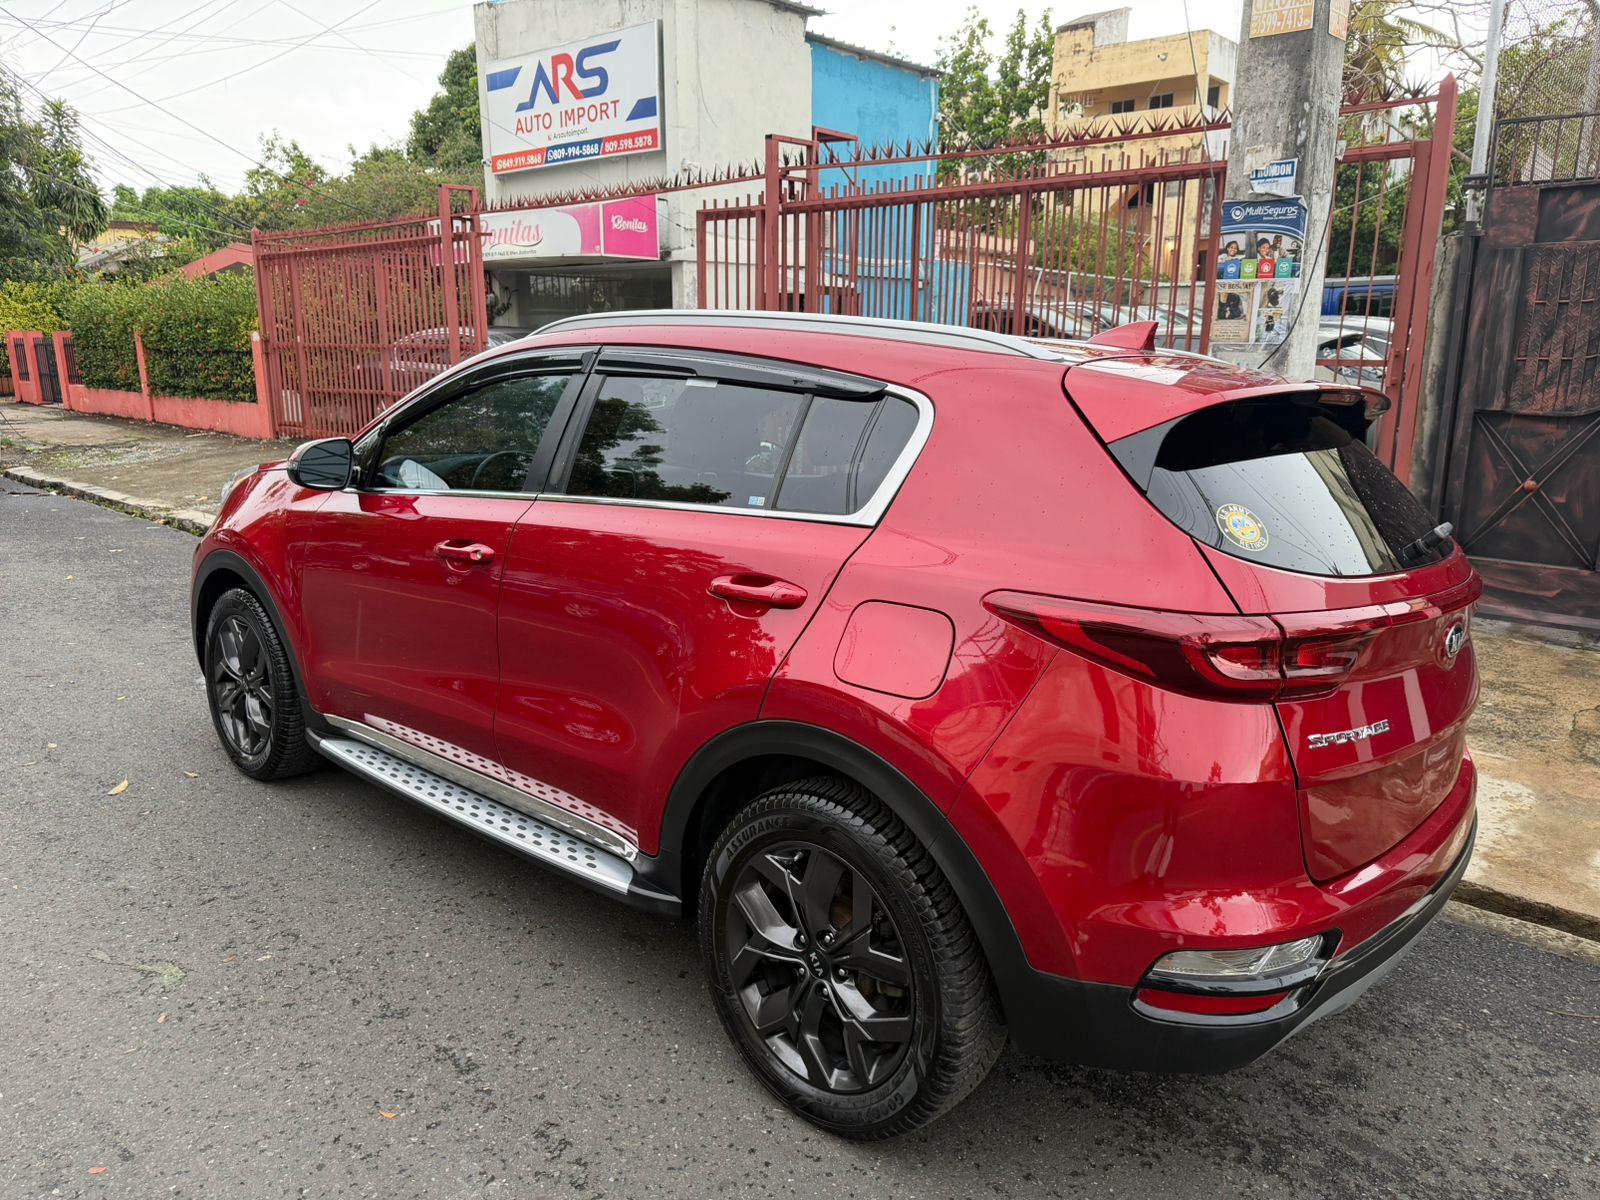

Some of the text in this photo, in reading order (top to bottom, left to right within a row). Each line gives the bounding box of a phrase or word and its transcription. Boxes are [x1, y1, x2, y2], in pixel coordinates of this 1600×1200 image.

[515, 39, 621, 112] ARS
[515, 100, 620, 136] AUTO IMPORT
[553, 143, 600, 161] 809-994-5868
[605, 135, 653, 153] 809.598.5878
[611, 214, 648, 233] Bonitas
[1245, 205, 1299, 217] MultiSeguros
[1307, 719, 1390, 748] SPORTAGE
[725, 816, 791, 860] ASSURANCE
[809, 951, 824, 977] KIA
